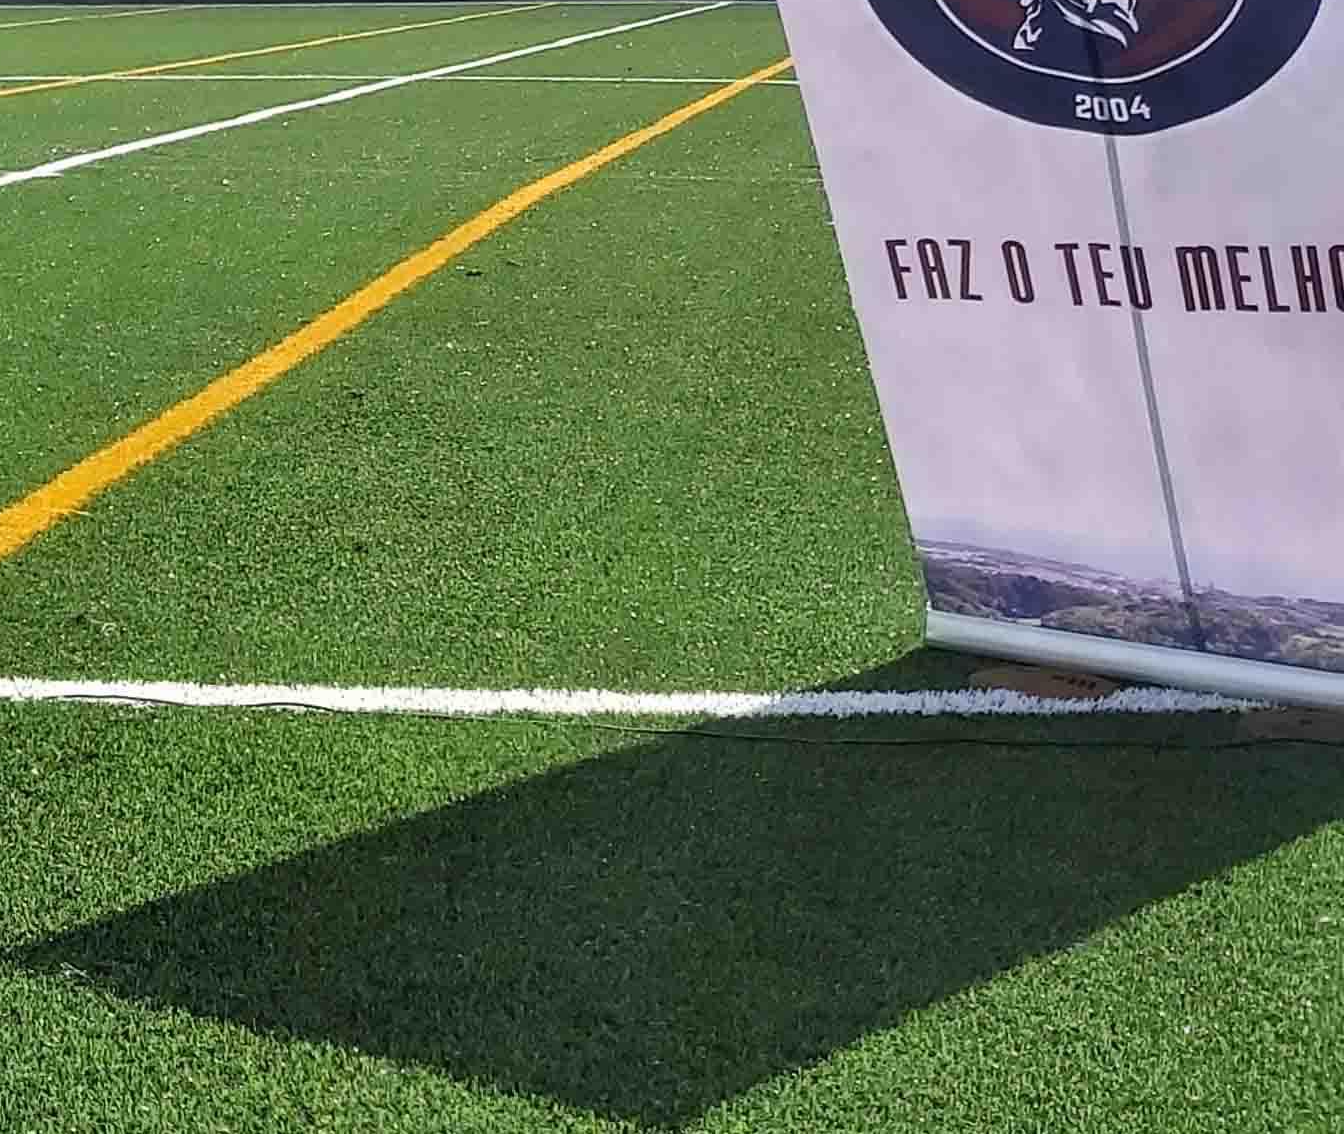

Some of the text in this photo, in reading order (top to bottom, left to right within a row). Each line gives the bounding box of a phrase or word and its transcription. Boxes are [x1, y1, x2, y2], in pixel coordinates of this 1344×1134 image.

[1074, 93, 1152, 123] 2004
[884, 237, 984, 302] FAZ
[1000, 239, 1036, 305] O
[1053, 242, 1153, 311] TEU
